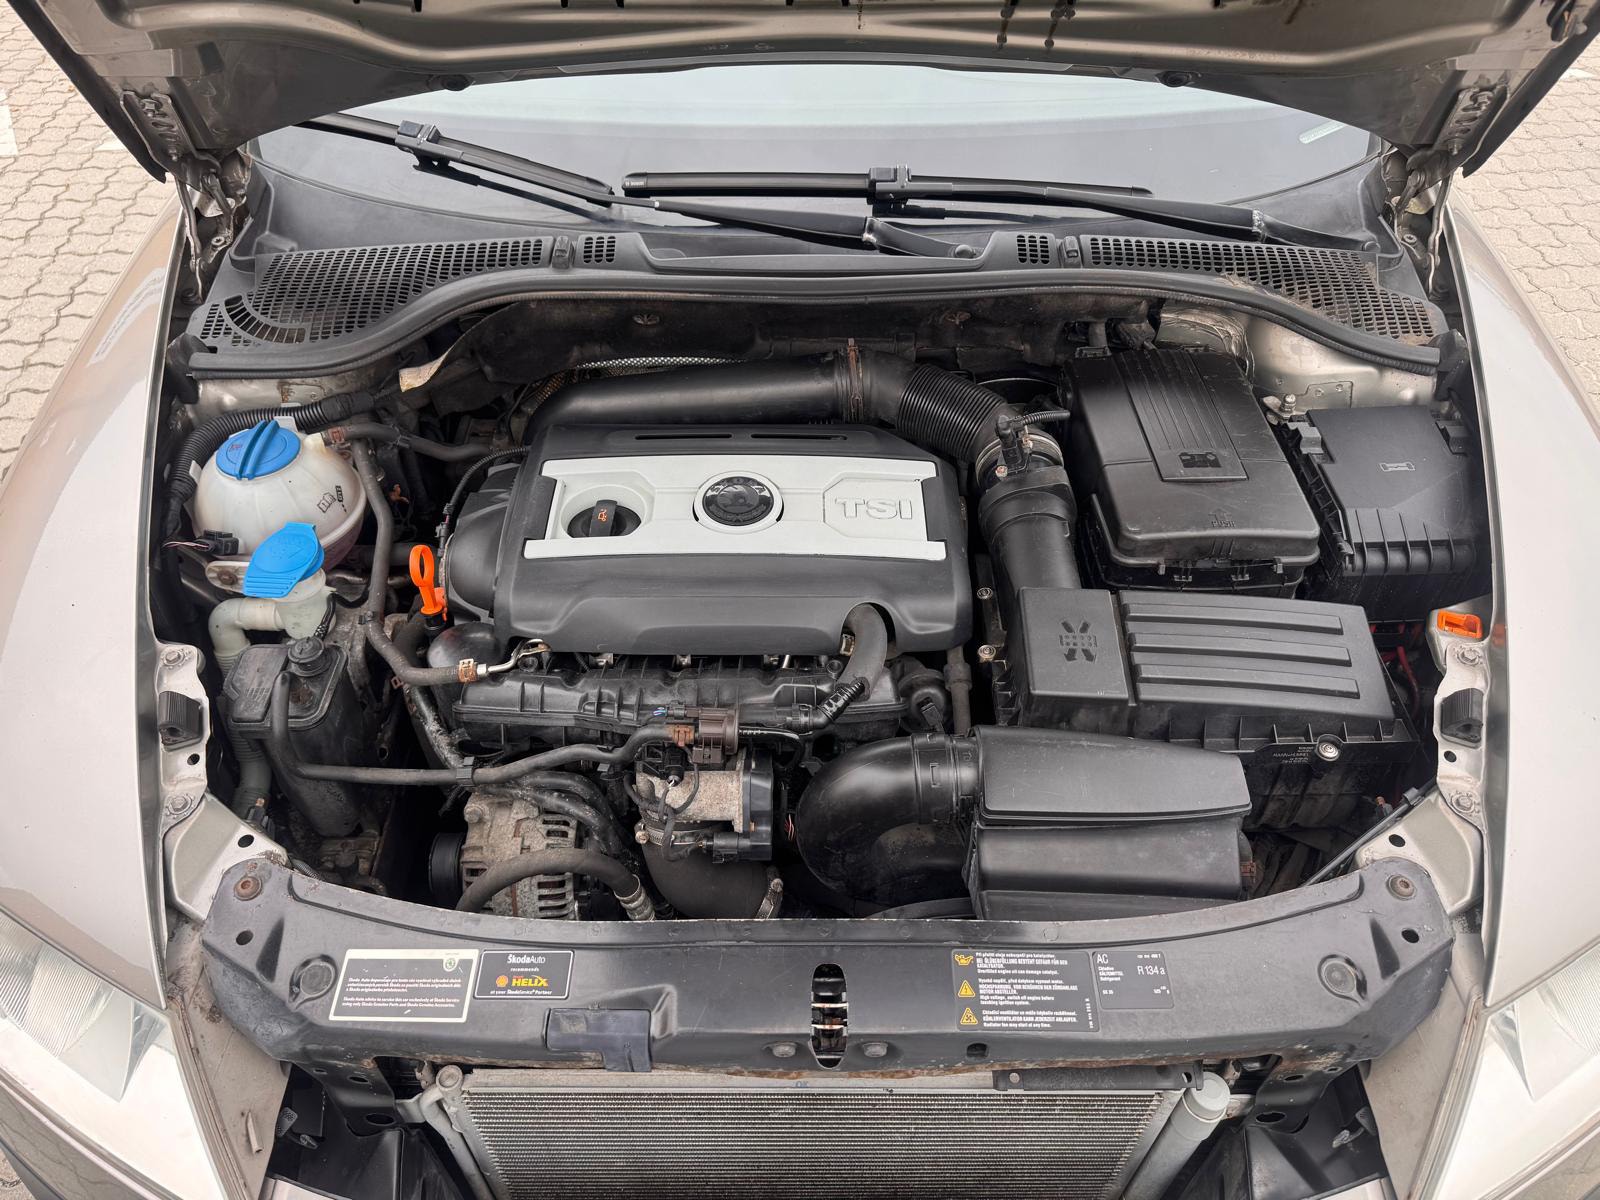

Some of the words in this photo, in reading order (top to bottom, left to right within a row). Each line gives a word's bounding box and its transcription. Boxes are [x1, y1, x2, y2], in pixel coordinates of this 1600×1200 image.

[835, 497, 912, 520] TSI
[1097, 954, 1108, 964] AC
[1137, 966, 1144, 975] R
[1145, 966, 1159, 975] 134
[511, 974, 549, 986] HELIX
